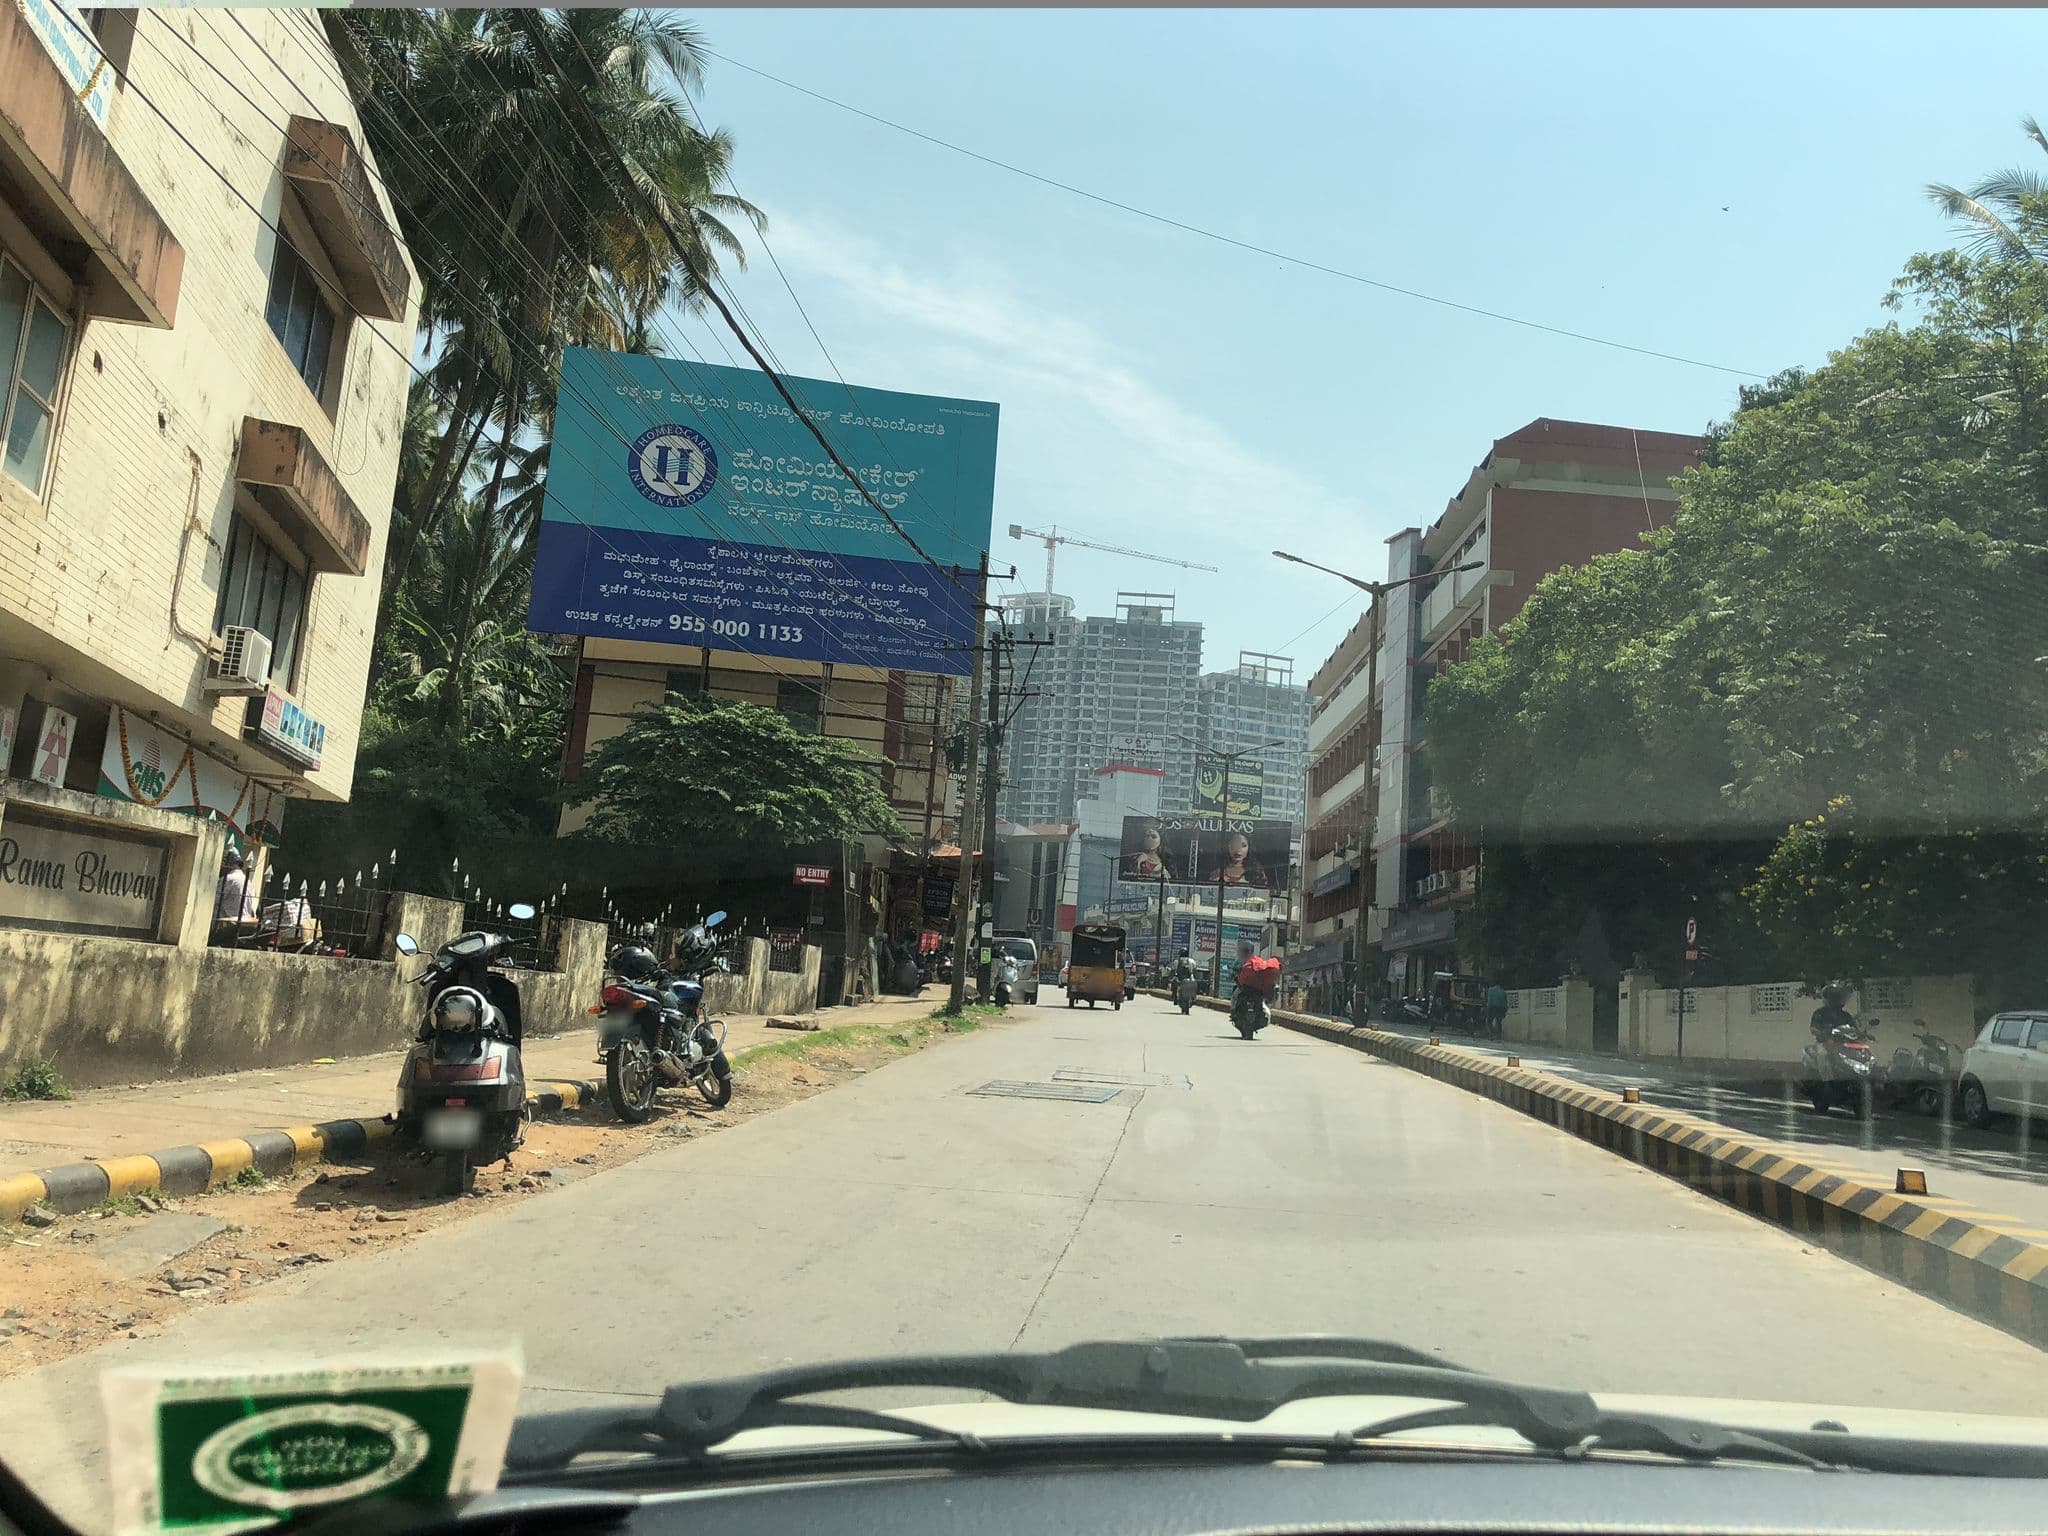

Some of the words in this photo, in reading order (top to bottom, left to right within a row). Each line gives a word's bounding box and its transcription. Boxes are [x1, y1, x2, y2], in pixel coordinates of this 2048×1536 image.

[839, 412, 946, 436] ಹೋಮಿಯೋಪತಿ
[638, 425, 712, 455] HOMEOCARE
[630, 468, 715, 507] INTERNATIONAL
[668, 613, 707, 634] 955
[711, 618, 750, 638] 000
[757, 623, 804, 643] 1133
[0, 837, 66, 890] Rama
[74, 850, 157, 901] Bhavan
[796, 866, 806, 877] NO
[807, 867, 831, 879] ENTRY
